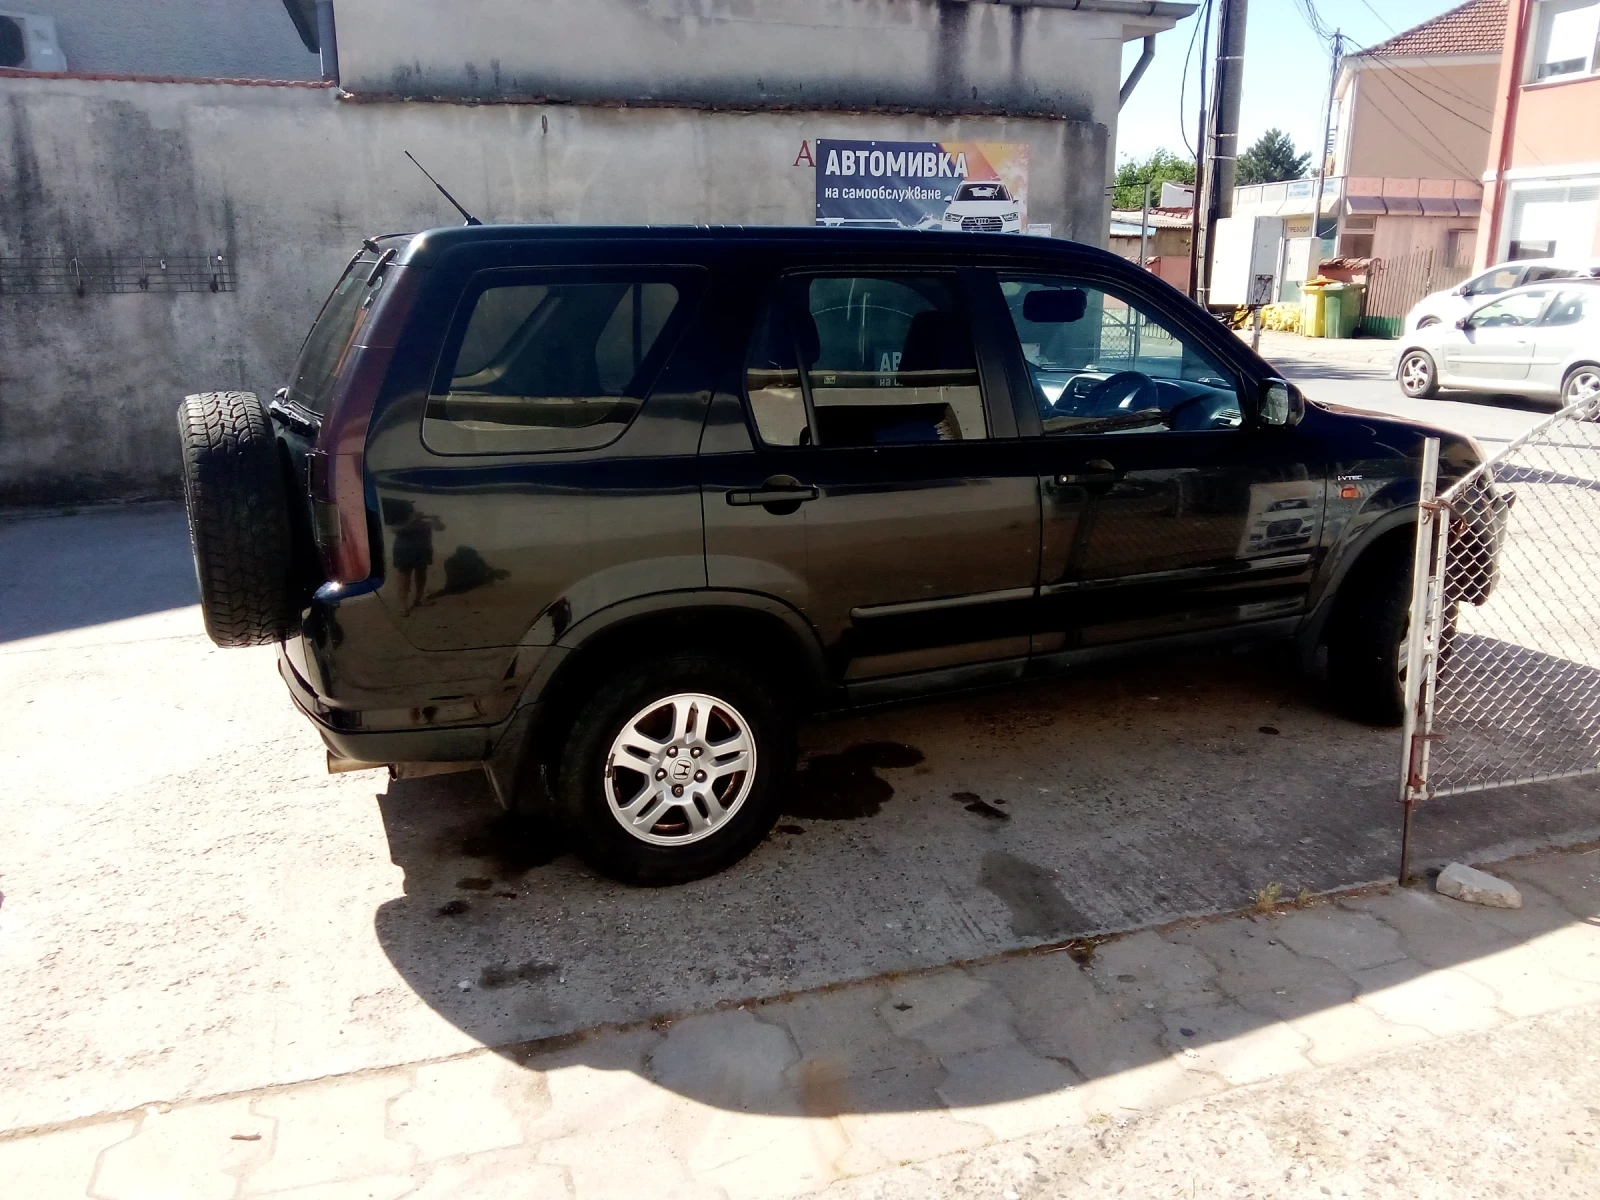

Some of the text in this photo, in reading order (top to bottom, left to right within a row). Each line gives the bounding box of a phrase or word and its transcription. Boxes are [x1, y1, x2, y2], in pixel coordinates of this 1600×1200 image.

[825, 149, 969, 178] АВТОМИВКА
[825, 185, 941, 203] на самообслужване
